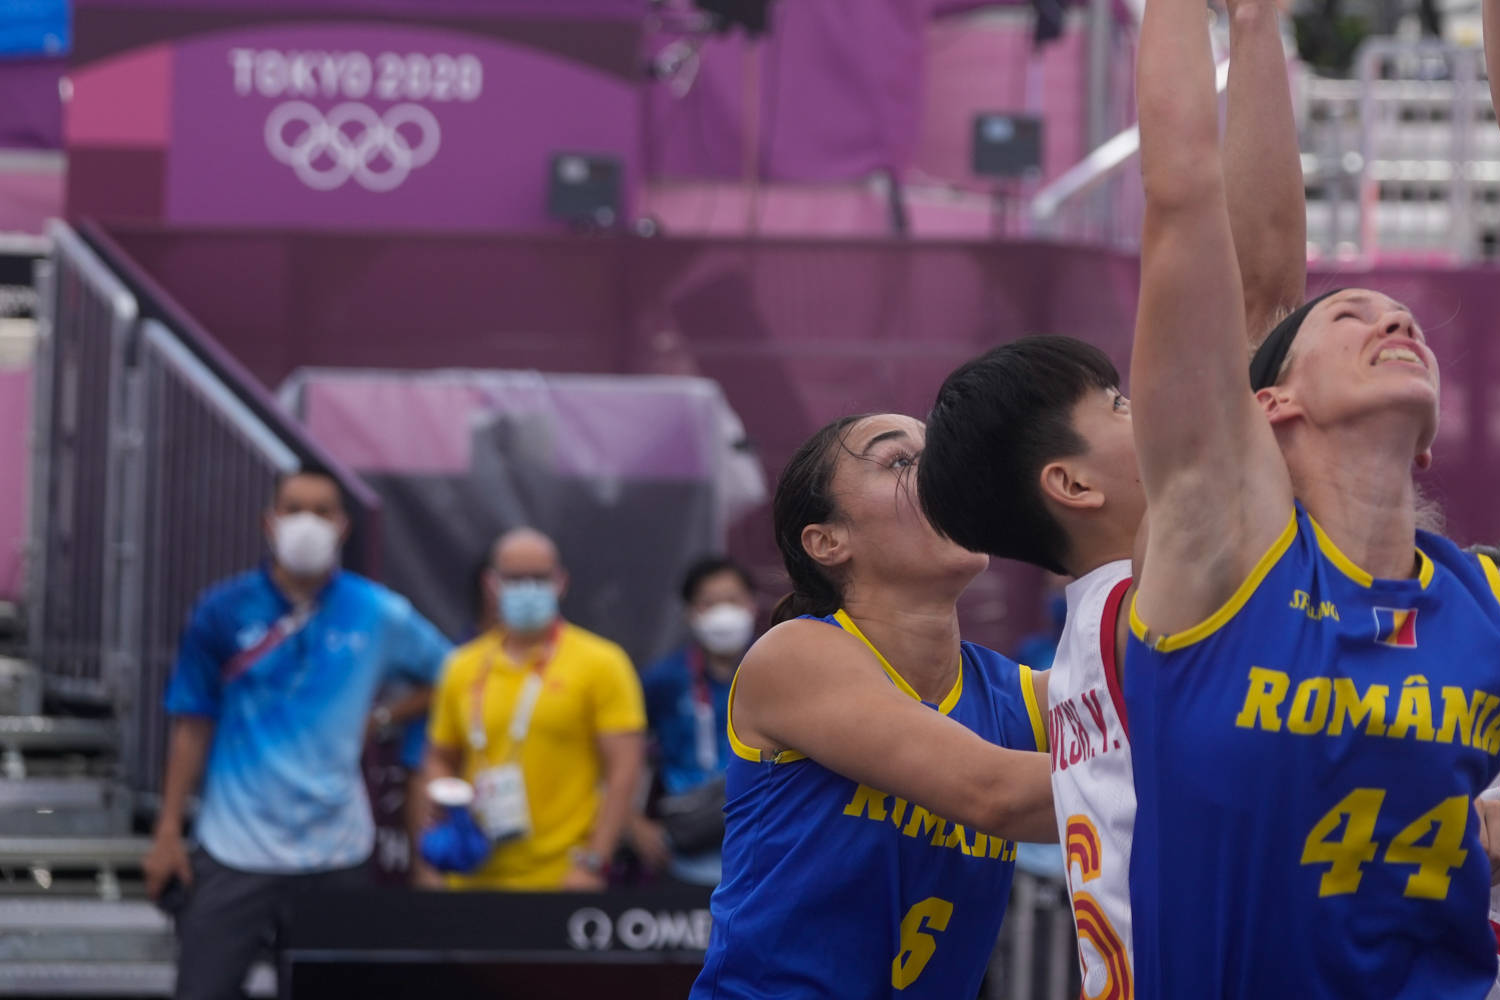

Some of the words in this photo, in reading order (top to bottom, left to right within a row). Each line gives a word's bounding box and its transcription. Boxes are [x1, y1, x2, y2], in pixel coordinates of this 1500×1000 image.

[229, 48, 373, 99] TOKYO
[375, 52, 483, 101] 2020
[1300, 788, 1470, 900] 44
[892, 897, 954, 990] 6
